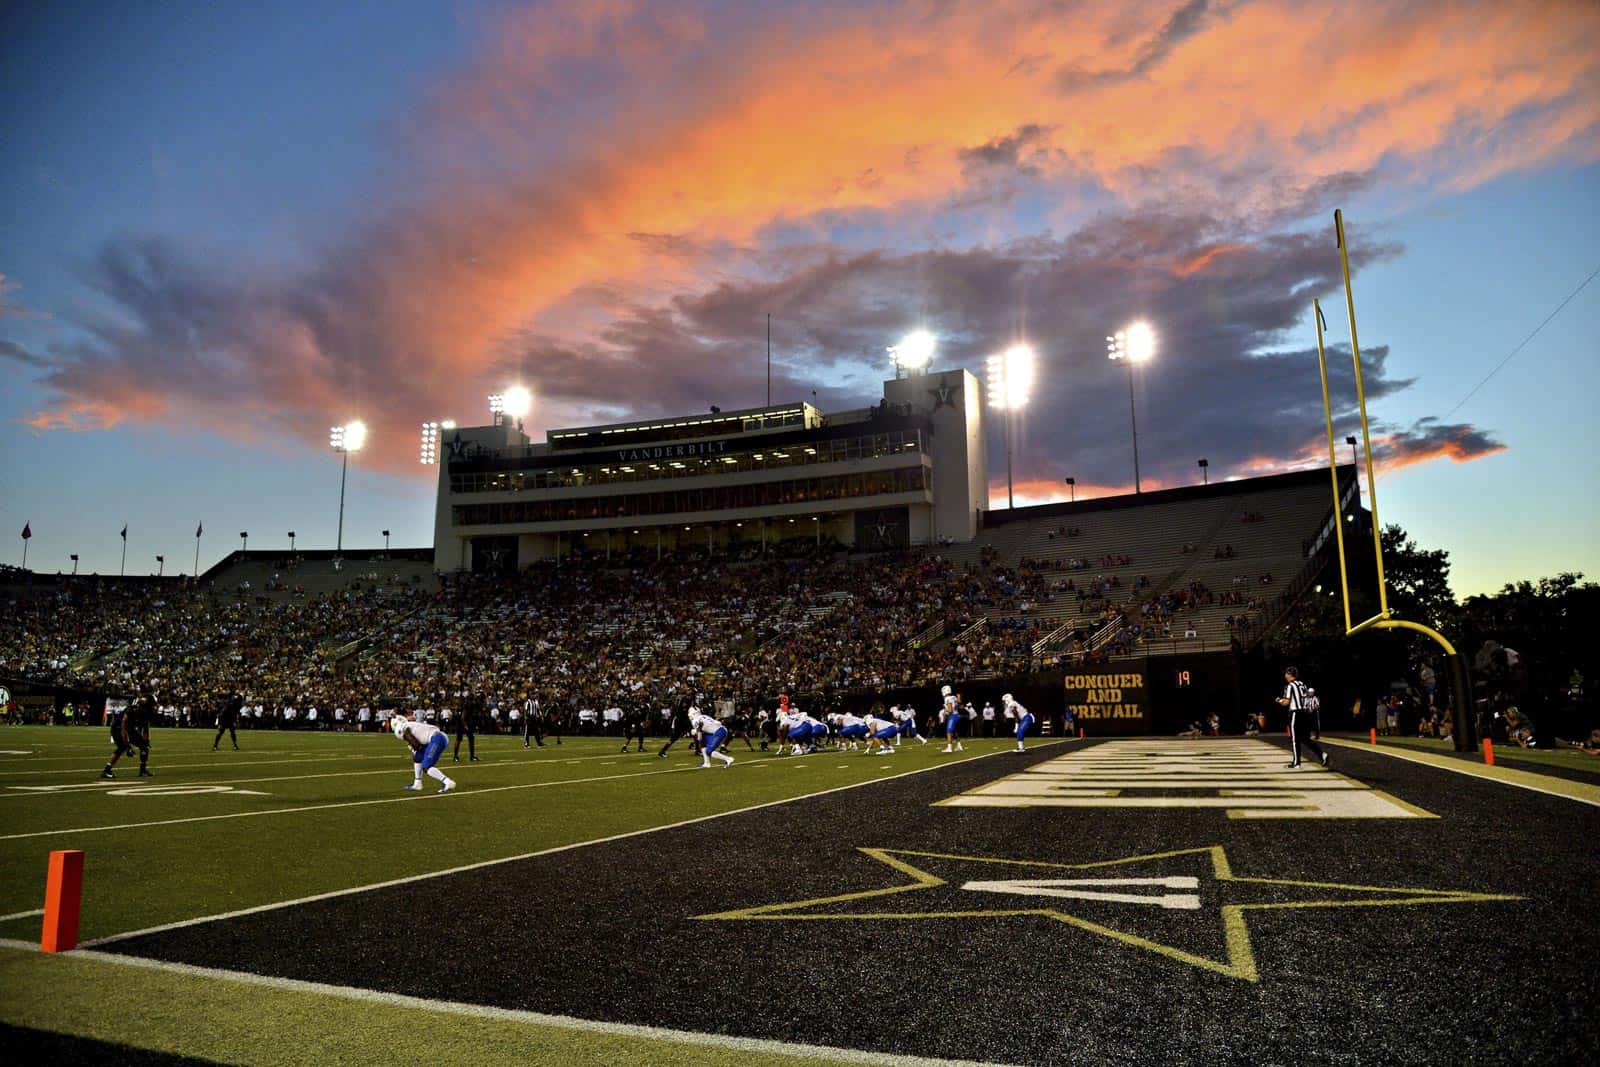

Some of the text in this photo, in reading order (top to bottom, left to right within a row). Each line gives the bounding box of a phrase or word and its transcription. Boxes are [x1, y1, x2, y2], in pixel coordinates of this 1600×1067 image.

[939, 388, 949, 401] V
[619, 441, 726, 460] VANDERBILT
[1065, 673, 1144, 689] CONQUER
[1178, 671, 1190, 686] 19
[1086, 689, 1122, 703] AND
[960, 876, 1200, 910] V
